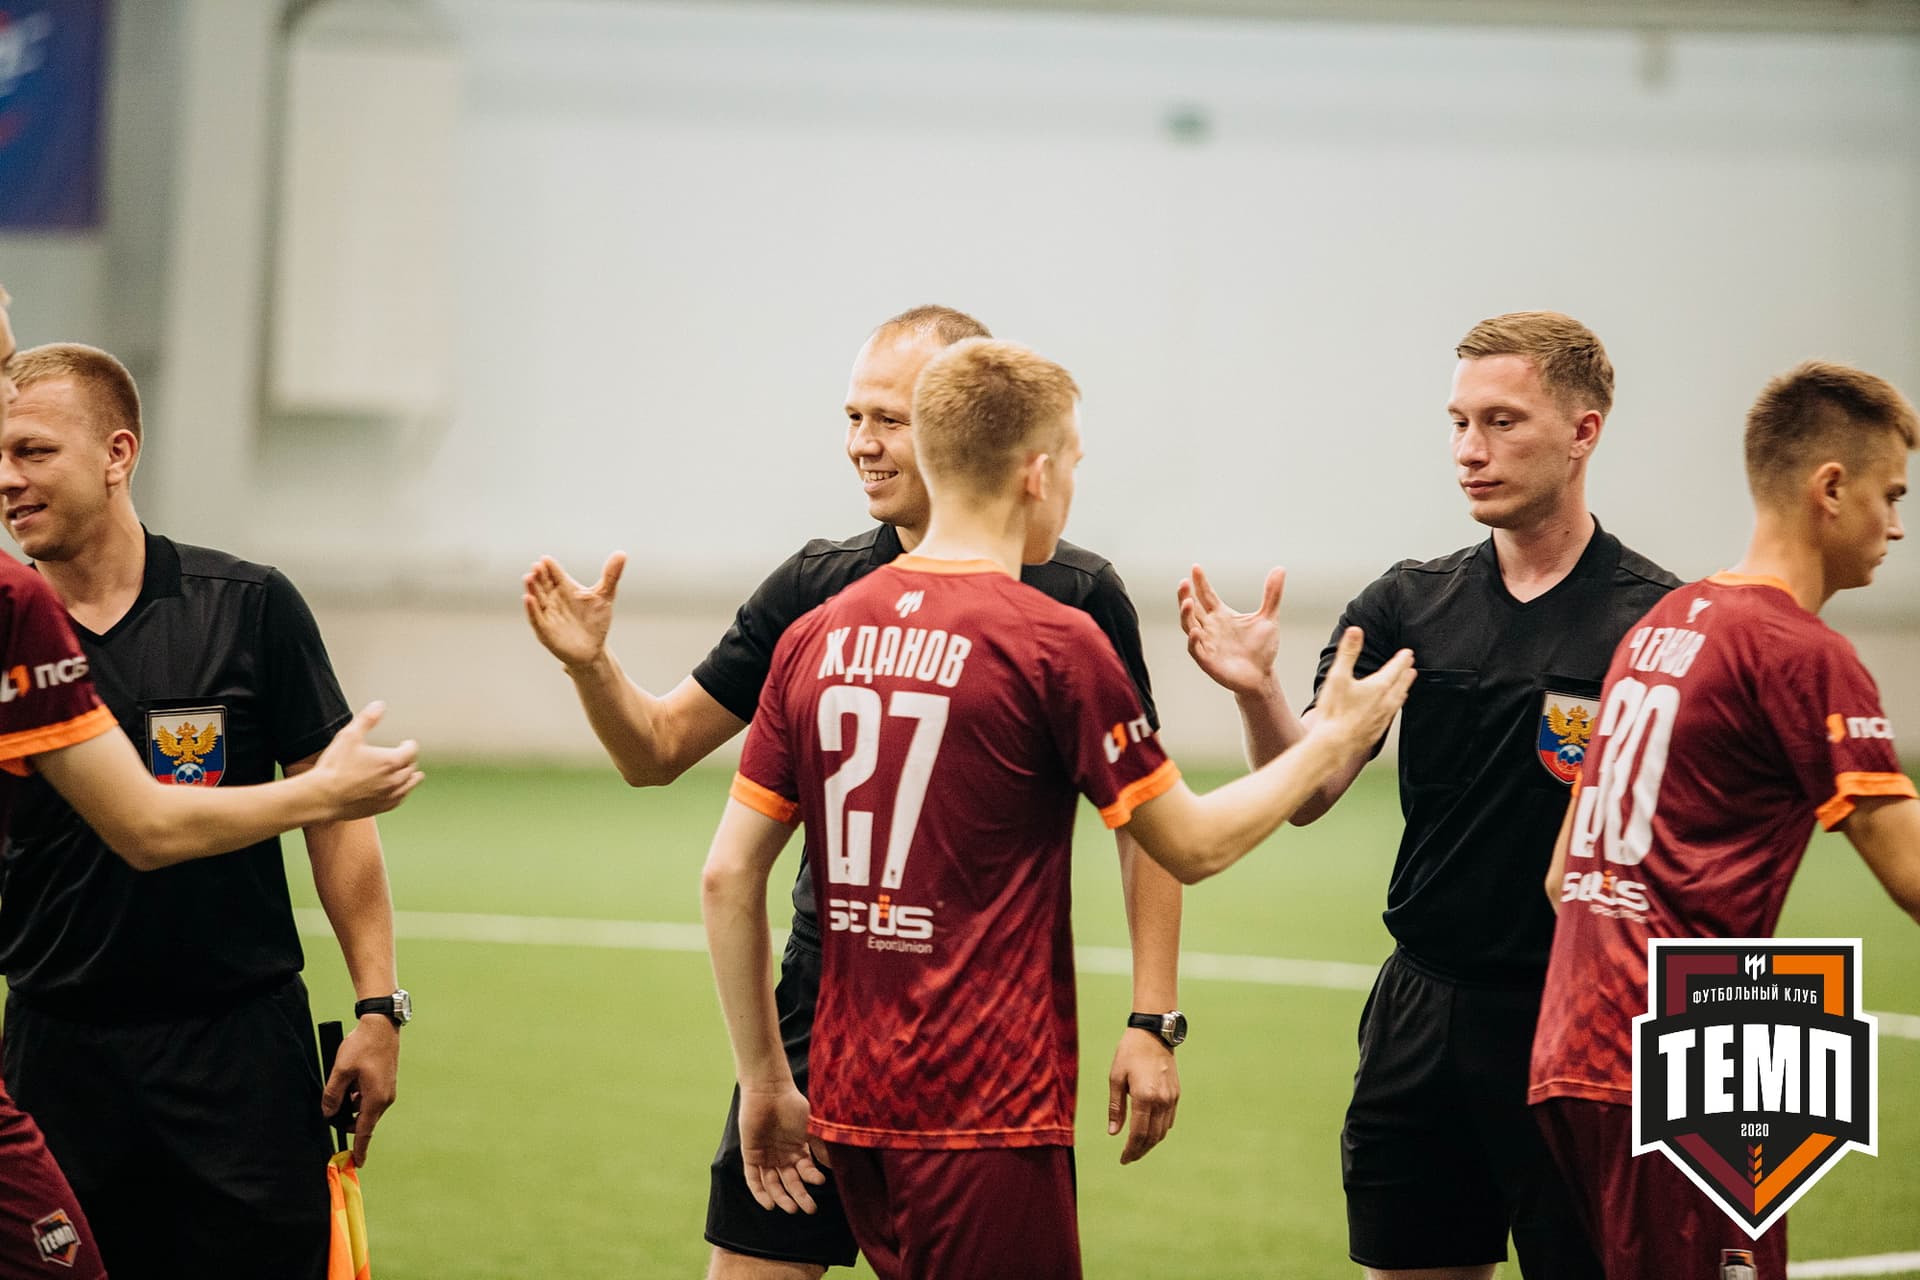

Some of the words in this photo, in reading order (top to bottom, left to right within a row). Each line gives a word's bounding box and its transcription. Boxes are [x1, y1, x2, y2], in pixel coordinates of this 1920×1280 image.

[817, 625, 972, 688] ЖДАНОВ
[817, 685, 950, 890] 27
[829, 896, 934, 939] SEUS
